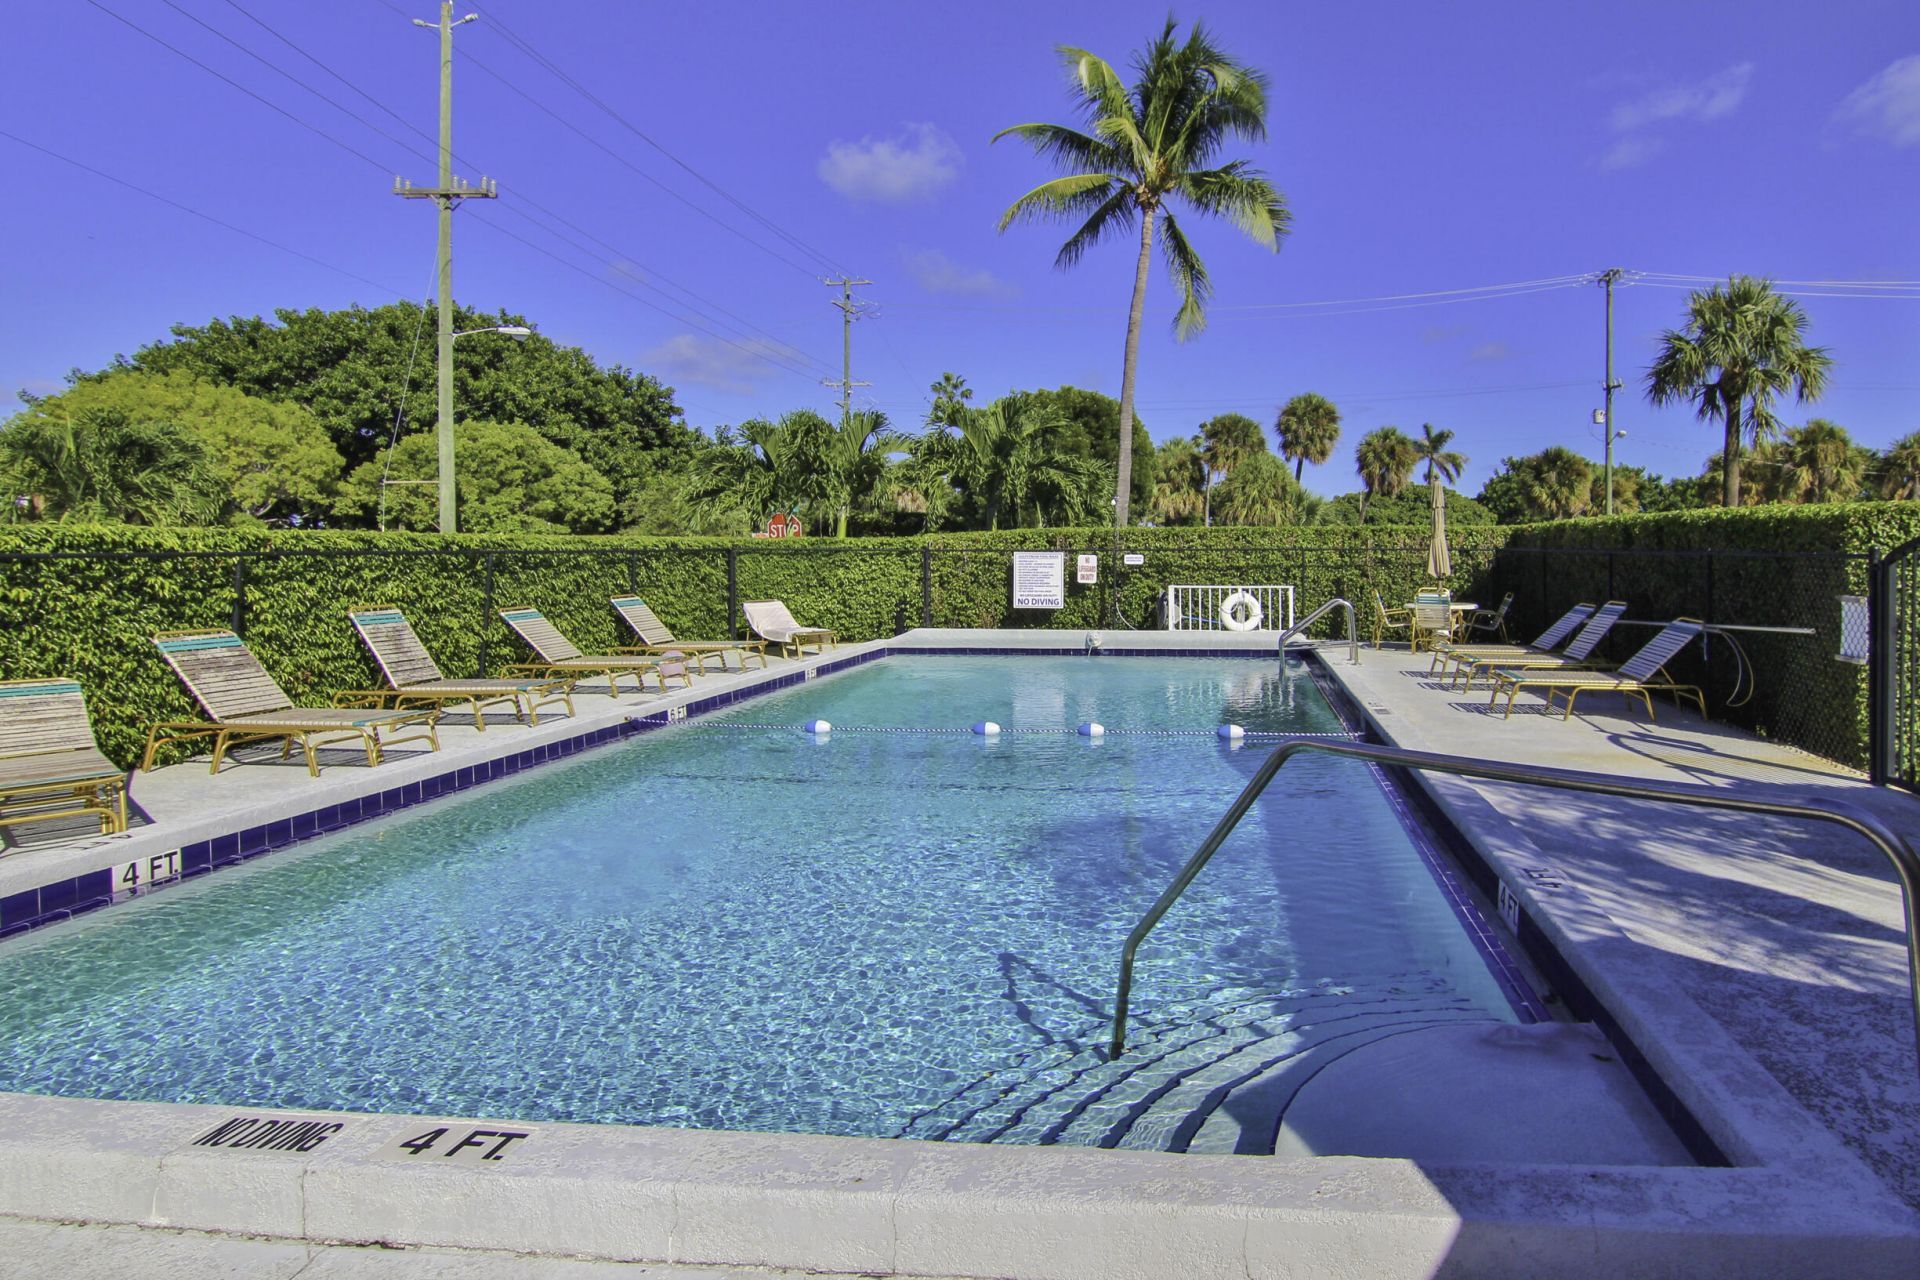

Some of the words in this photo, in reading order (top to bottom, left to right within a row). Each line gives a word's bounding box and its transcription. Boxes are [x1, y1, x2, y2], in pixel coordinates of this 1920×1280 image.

[770, 524, 799, 538] STP
[122, 861, 140, 885] 4
[1500, 886, 1506, 910] 4
[191, 1117, 260, 1147] NO
[227, 1119, 344, 1152] DIVING
[399, 1127, 449, 1155] 4
[443, 1130, 529, 1161] FT.
